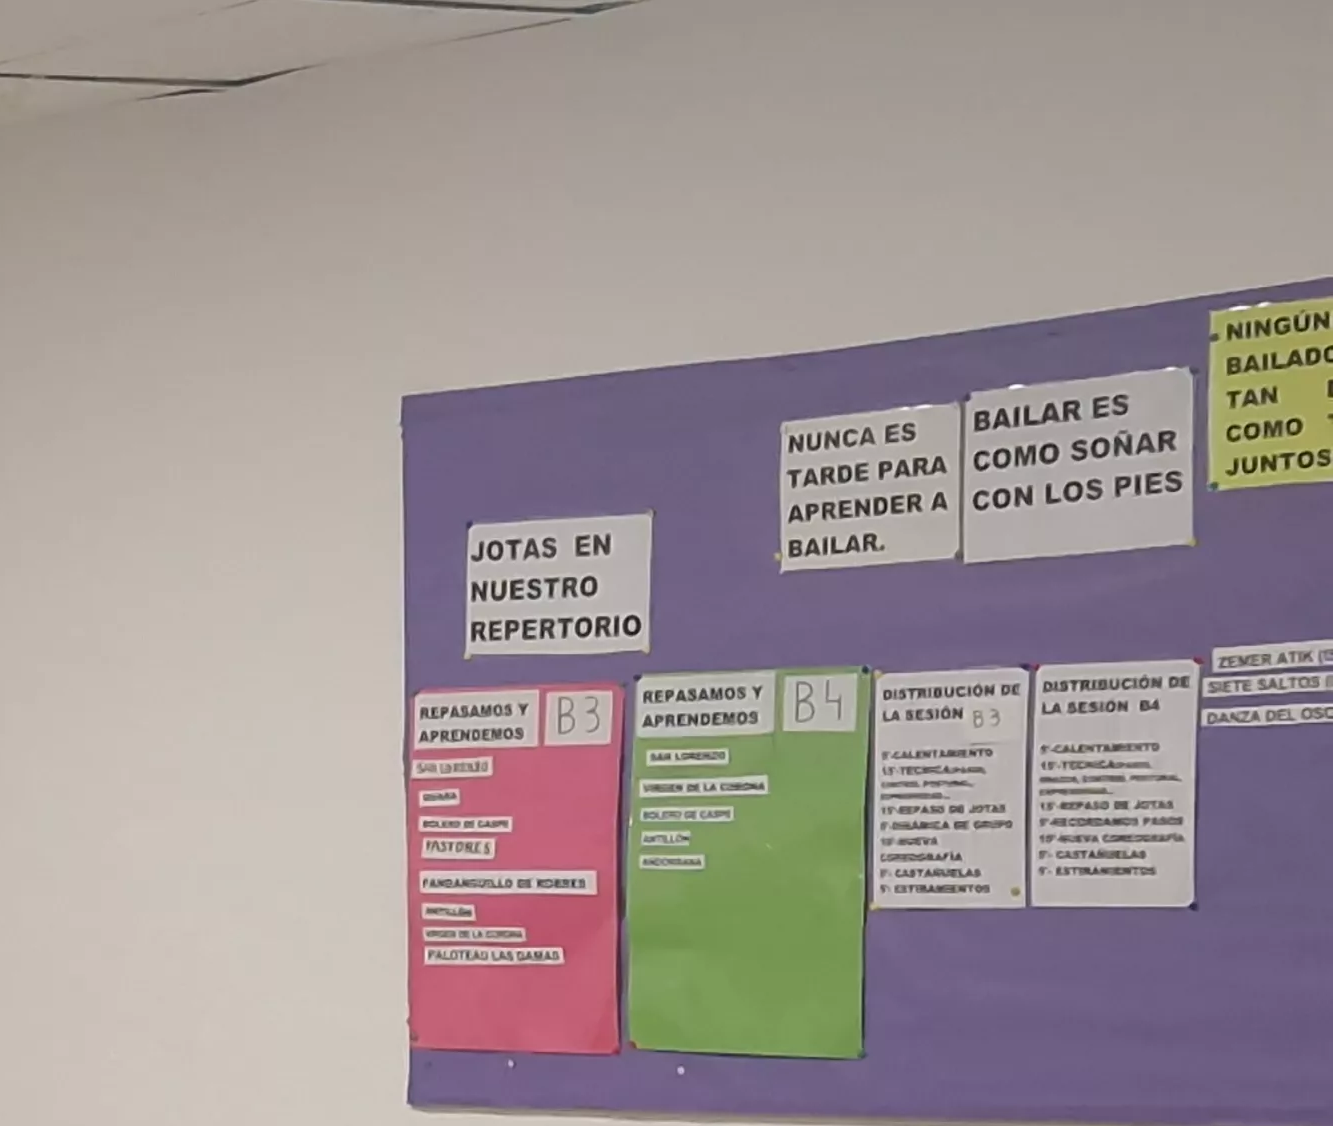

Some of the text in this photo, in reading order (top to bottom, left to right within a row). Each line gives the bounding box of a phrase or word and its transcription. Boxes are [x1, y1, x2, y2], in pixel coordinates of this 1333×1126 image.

[1225, 310, 1331, 341] NINGÚN
[1226, 386, 1279, 409] TAN
[973, 394, 1129, 432] BAILAR ES
[788, 422, 917, 454] NUNCA ES
[1225, 417, 1304, 443] COMO
[973, 429, 1177, 472] COMO SOÑAR
[1225, 449, 1332, 477] JUNTOS
[787, 456, 948, 489] TARDE PARA
[972, 470, 1183, 511] CON LOS PIES
[787, 491, 949, 524] APRENDER A
[470, 533, 612, 562] JOTAS EN
[788, 532, 886, 558] BAILAR.
[470, 575, 599, 602] NUESTRO
[470, 614, 642, 643] REPERTORIO
[1277, 650, 1314, 665] ATIK
[642, 684, 763, 704] REPASAMOS Y
[883, 681, 1021, 701] DISTRIBUCIÓN DE
[1042, 674, 1190, 693] DISTRIBUCIÓN DE
[1207, 680, 1252, 694] SIETE
[1256, 676, 1321, 691] SALTOS
[419, 702, 529, 721] REPASAMOS Y
[795, 679, 843, 723] B4
[882, 706, 964, 722] LA SESIÓN
[1041, 701, 1062, 715] LA
[1066, 697, 1129, 714] SESIÓN
[557, 696, 601, 735] B3
[642, 711, 759, 728] APRENDEMOS
[1206, 710, 1261, 725] DANZA
[1266, 708, 1297, 722] DEL
[419, 727, 525, 743] APRENDEMOS
